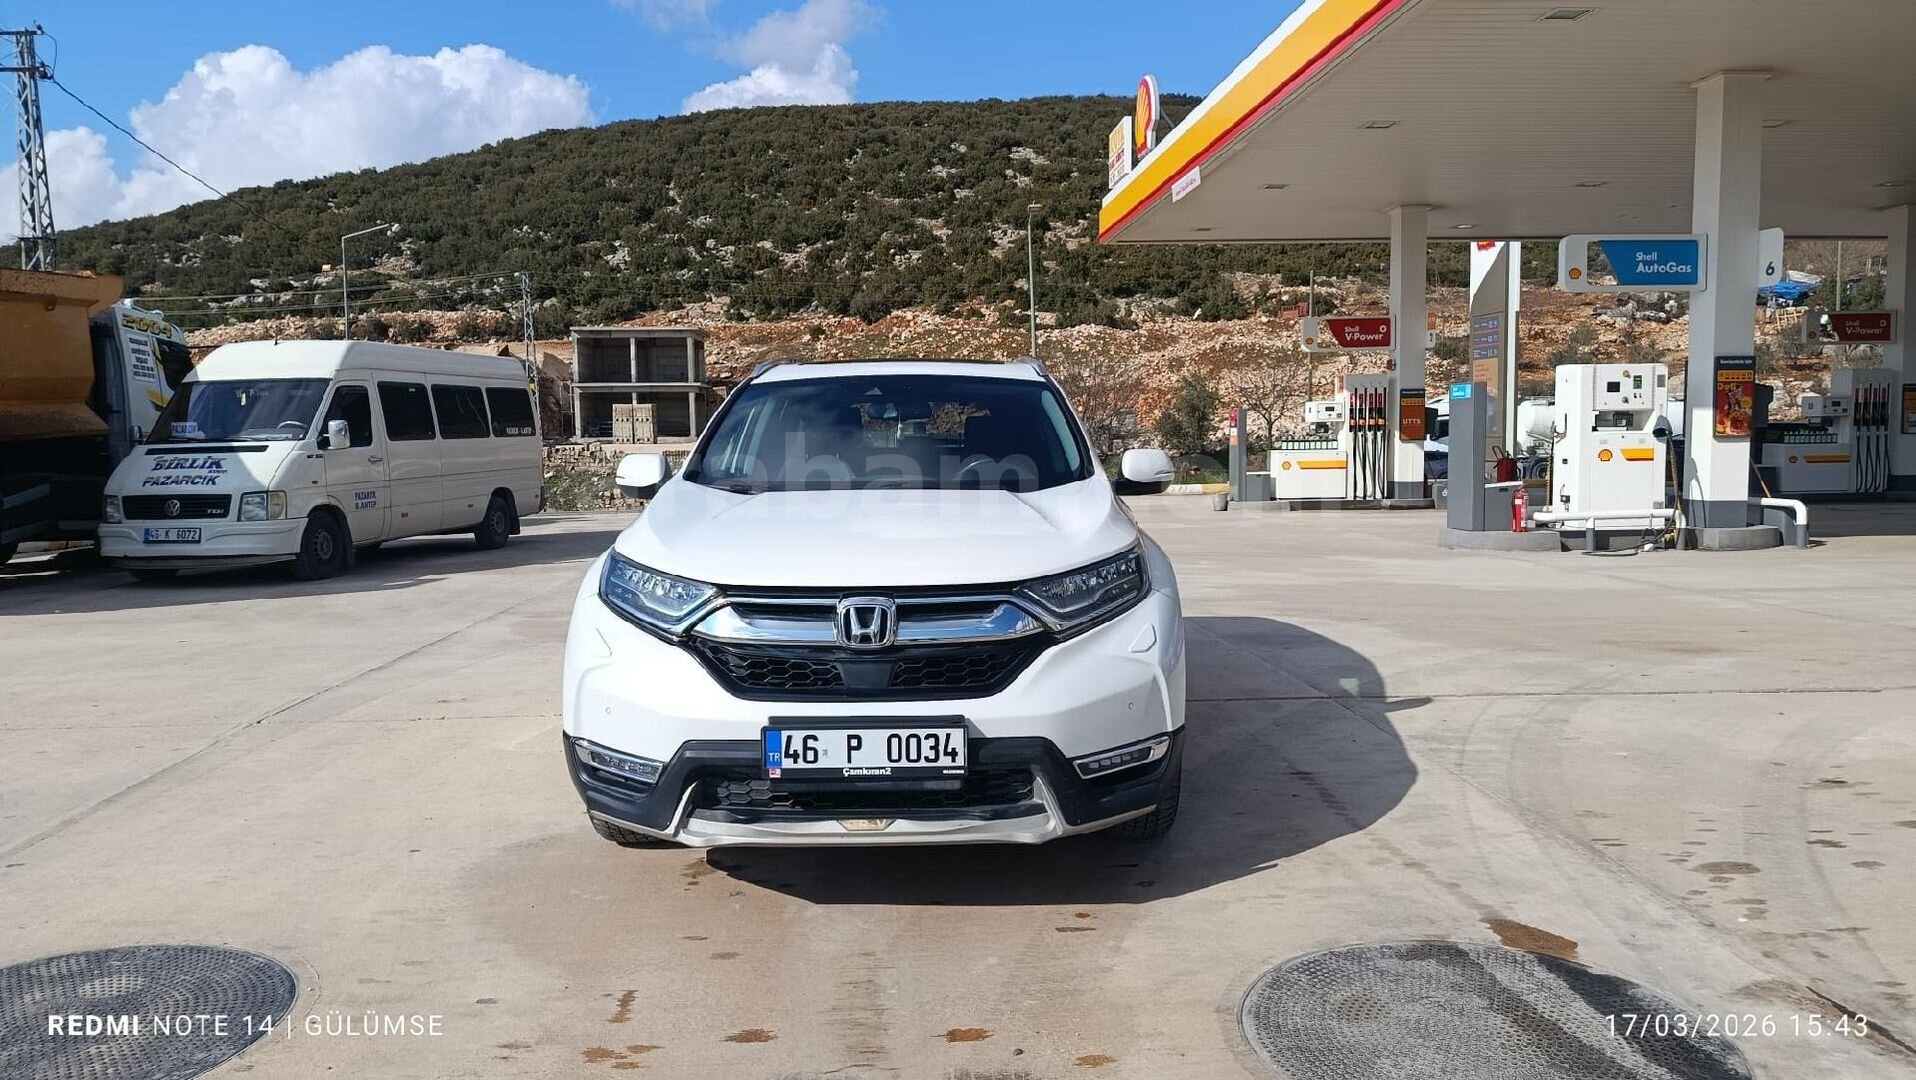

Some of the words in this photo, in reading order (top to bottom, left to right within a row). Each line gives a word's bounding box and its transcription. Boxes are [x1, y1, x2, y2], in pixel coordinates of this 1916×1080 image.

[1636, 252, 1658, 261] Shell
[1636, 262, 1692, 273] AutoGas
[1765, 261, 1775, 276] 6
[1345, 332, 1384, 341] V-Power
[783, 734, 819, 764] 46
[847, 734, 863, 764] P
[886, 733, 959, 764] 0034
[768, 752, 781, 762] TR
